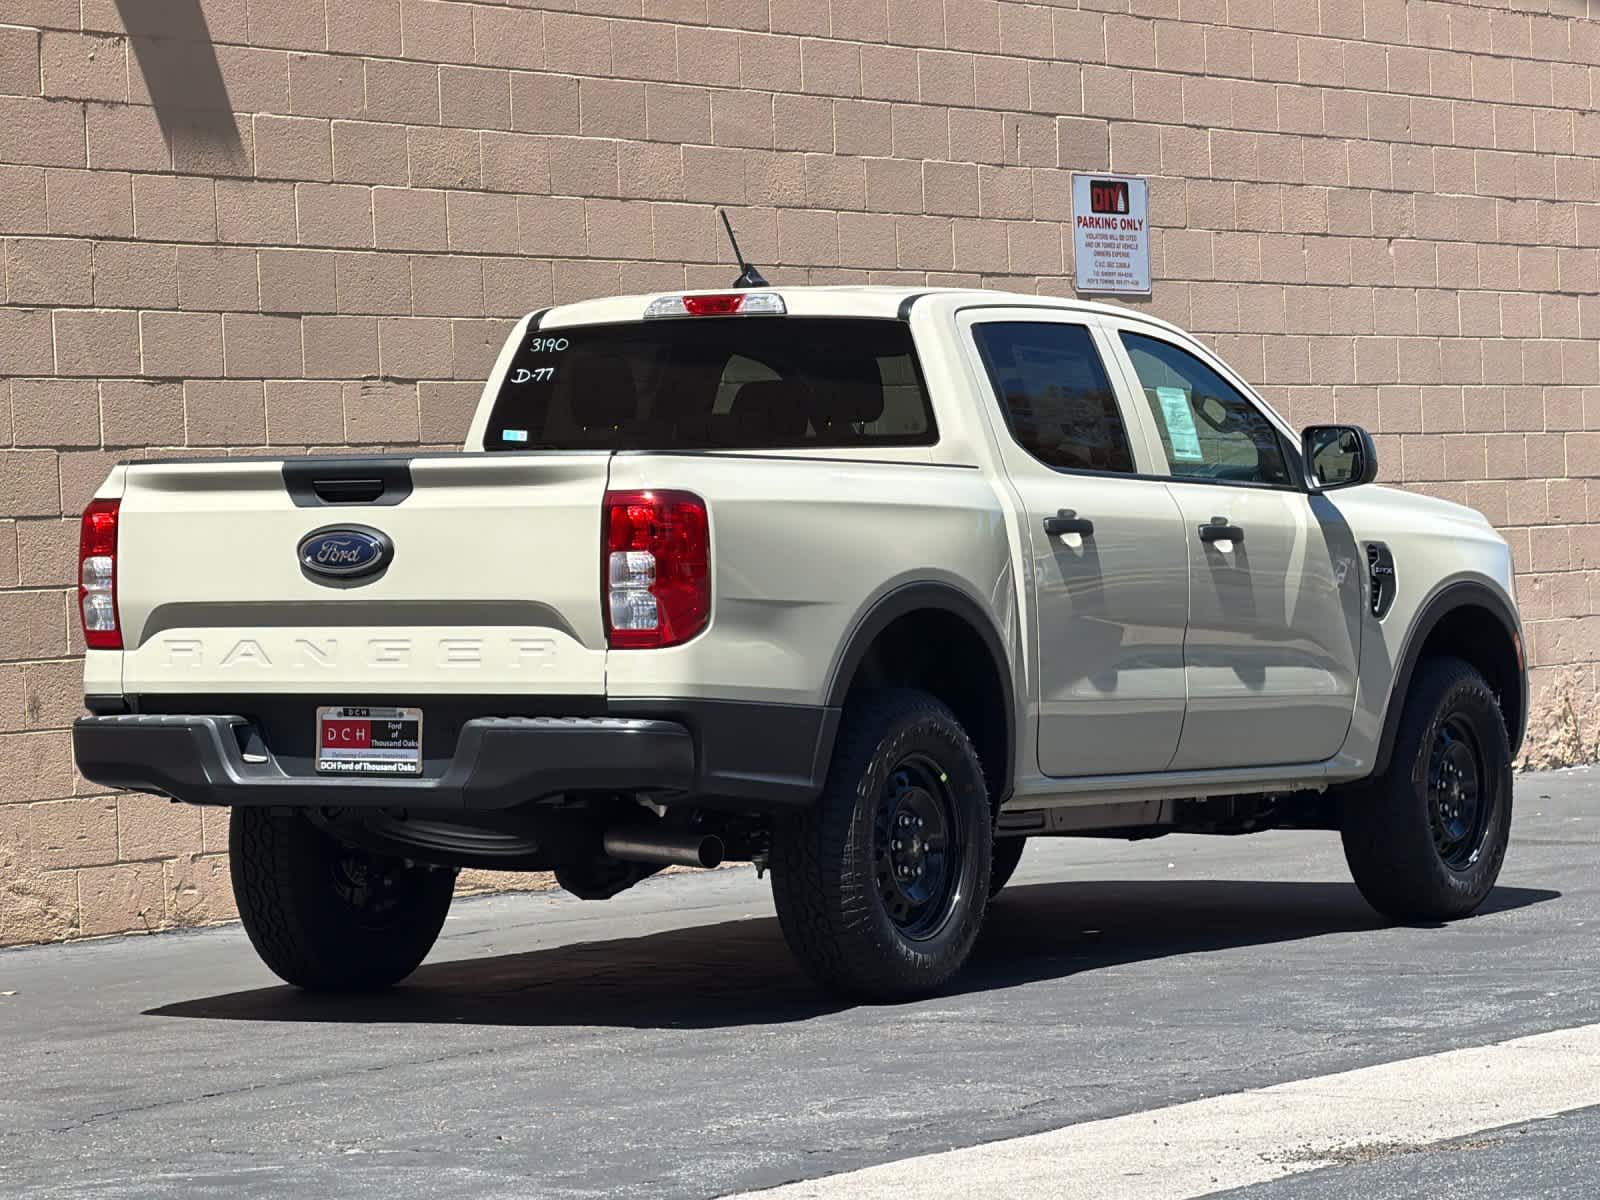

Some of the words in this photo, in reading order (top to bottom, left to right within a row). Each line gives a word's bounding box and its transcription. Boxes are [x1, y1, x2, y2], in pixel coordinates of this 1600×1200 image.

[1077, 216, 1118, 230] PARKING
[1120, 218, 1143, 231] ONLY
[530, 338, 569, 352] 3190
[511, 367, 554, 383] D-77
[317, 540, 362, 562] Ford
[161, 639, 557, 668] RANGER
[387, 722, 402, 730] Ford
[327, 727, 365, 741] DCH
[391, 730, 399, 738] of
[371, 739, 402, 747] Thousand
[320, 761, 337, 770] DCH
[337, 762, 354, 770] Ford
[354, 762, 362, 770] of
[363, 762, 397, 771] Thousand
[397, 763, 416, 772] Oaks
